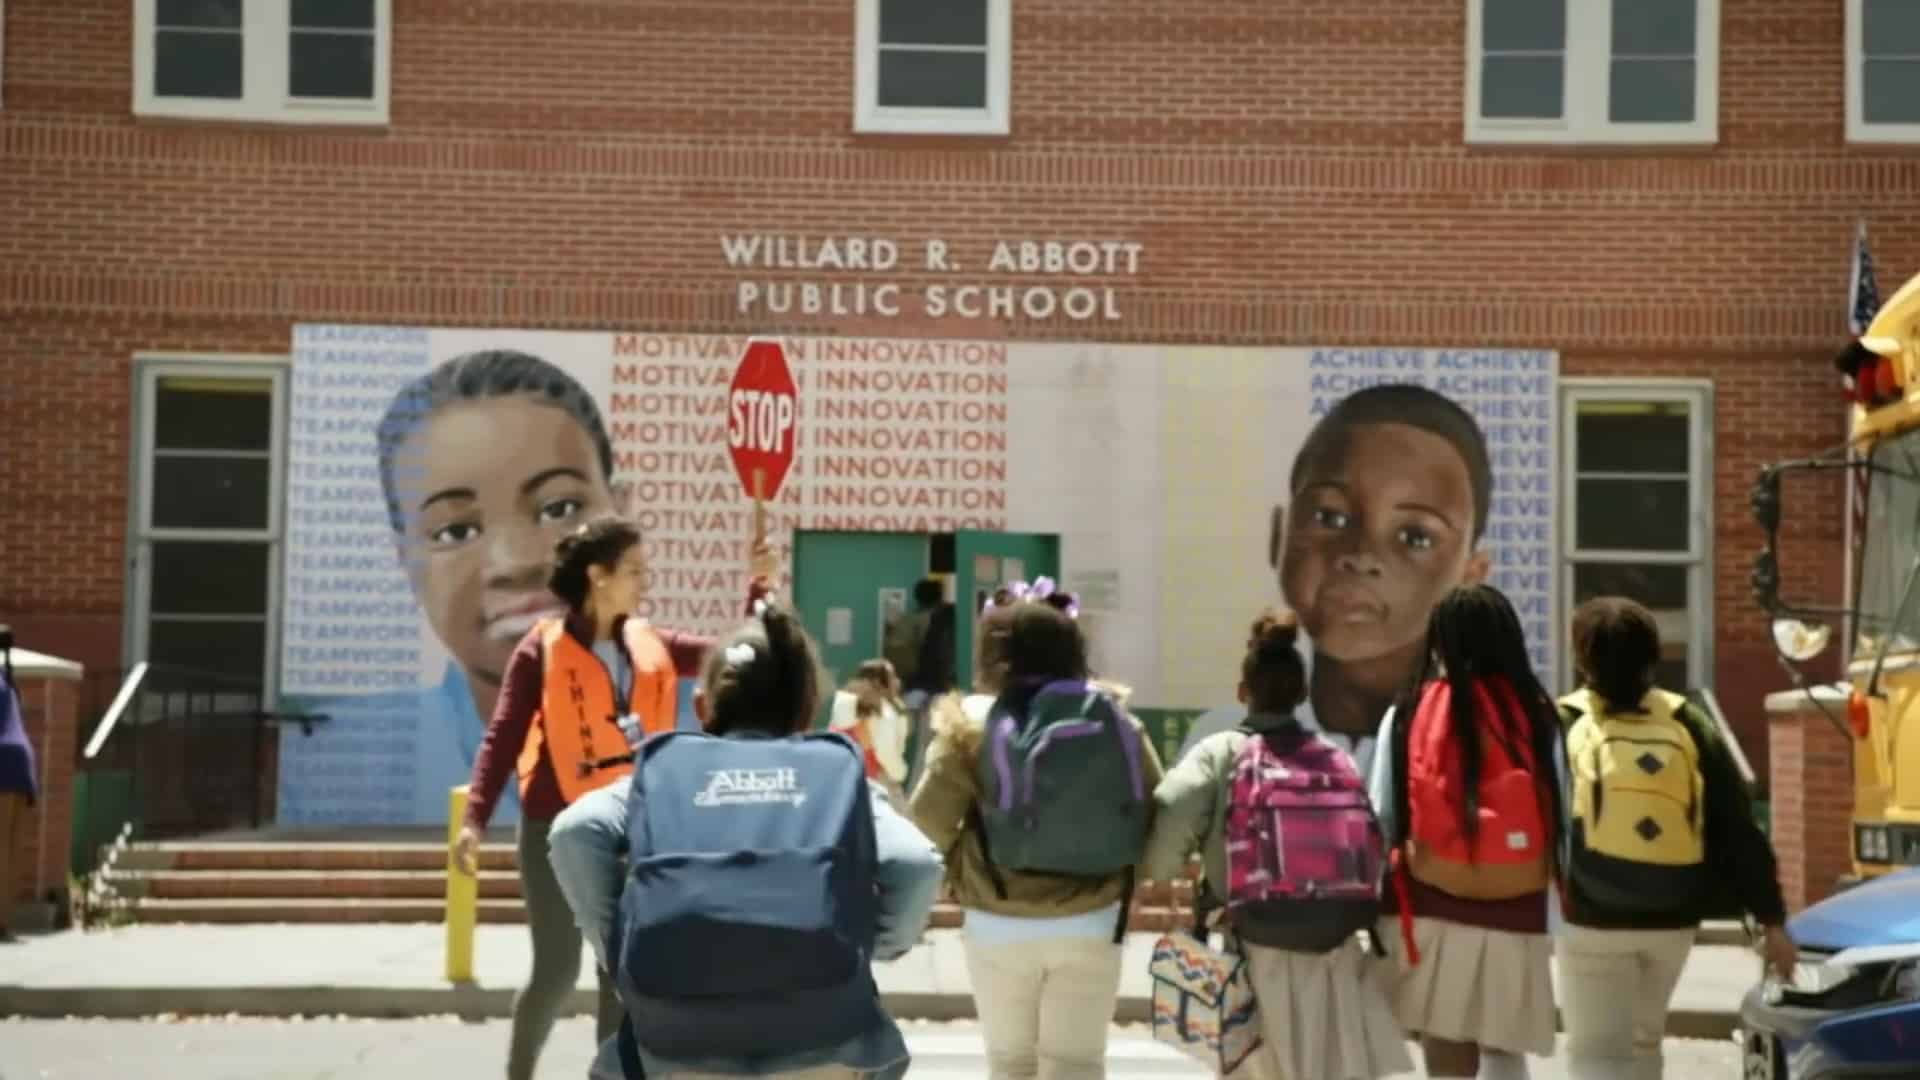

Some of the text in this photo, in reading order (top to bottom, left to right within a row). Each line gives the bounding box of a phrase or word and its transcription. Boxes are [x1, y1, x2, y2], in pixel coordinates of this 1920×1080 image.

[720, 236, 1144, 274] WILLARD R. ABBOTT
[737, 281, 1124, 320] PUBLIC SCHOOL
[295, 349, 427, 366] TEAMWORK
[815, 342, 1007, 365] INNOVATION
[1310, 350, 1550, 371] ACHIEVE ACHIEVE
[815, 369, 1007, 395] INNOVATION
[1434, 376, 1550, 395] ACHIEVE
[730, 389, 793, 453] STOP
[814, 398, 1007, 423] INNOVATION
[813, 427, 1007, 452] INNOVATION
[812, 455, 1007, 480] INNOVATION
[812, 485, 1007, 510] INNOVATION
[289, 623, 417, 640] TEAMWORK
[288, 647, 417, 663] TEAMWORK
[287, 669, 416, 686] TEAMWORK
[706, 767, 798, 791] Abbott
